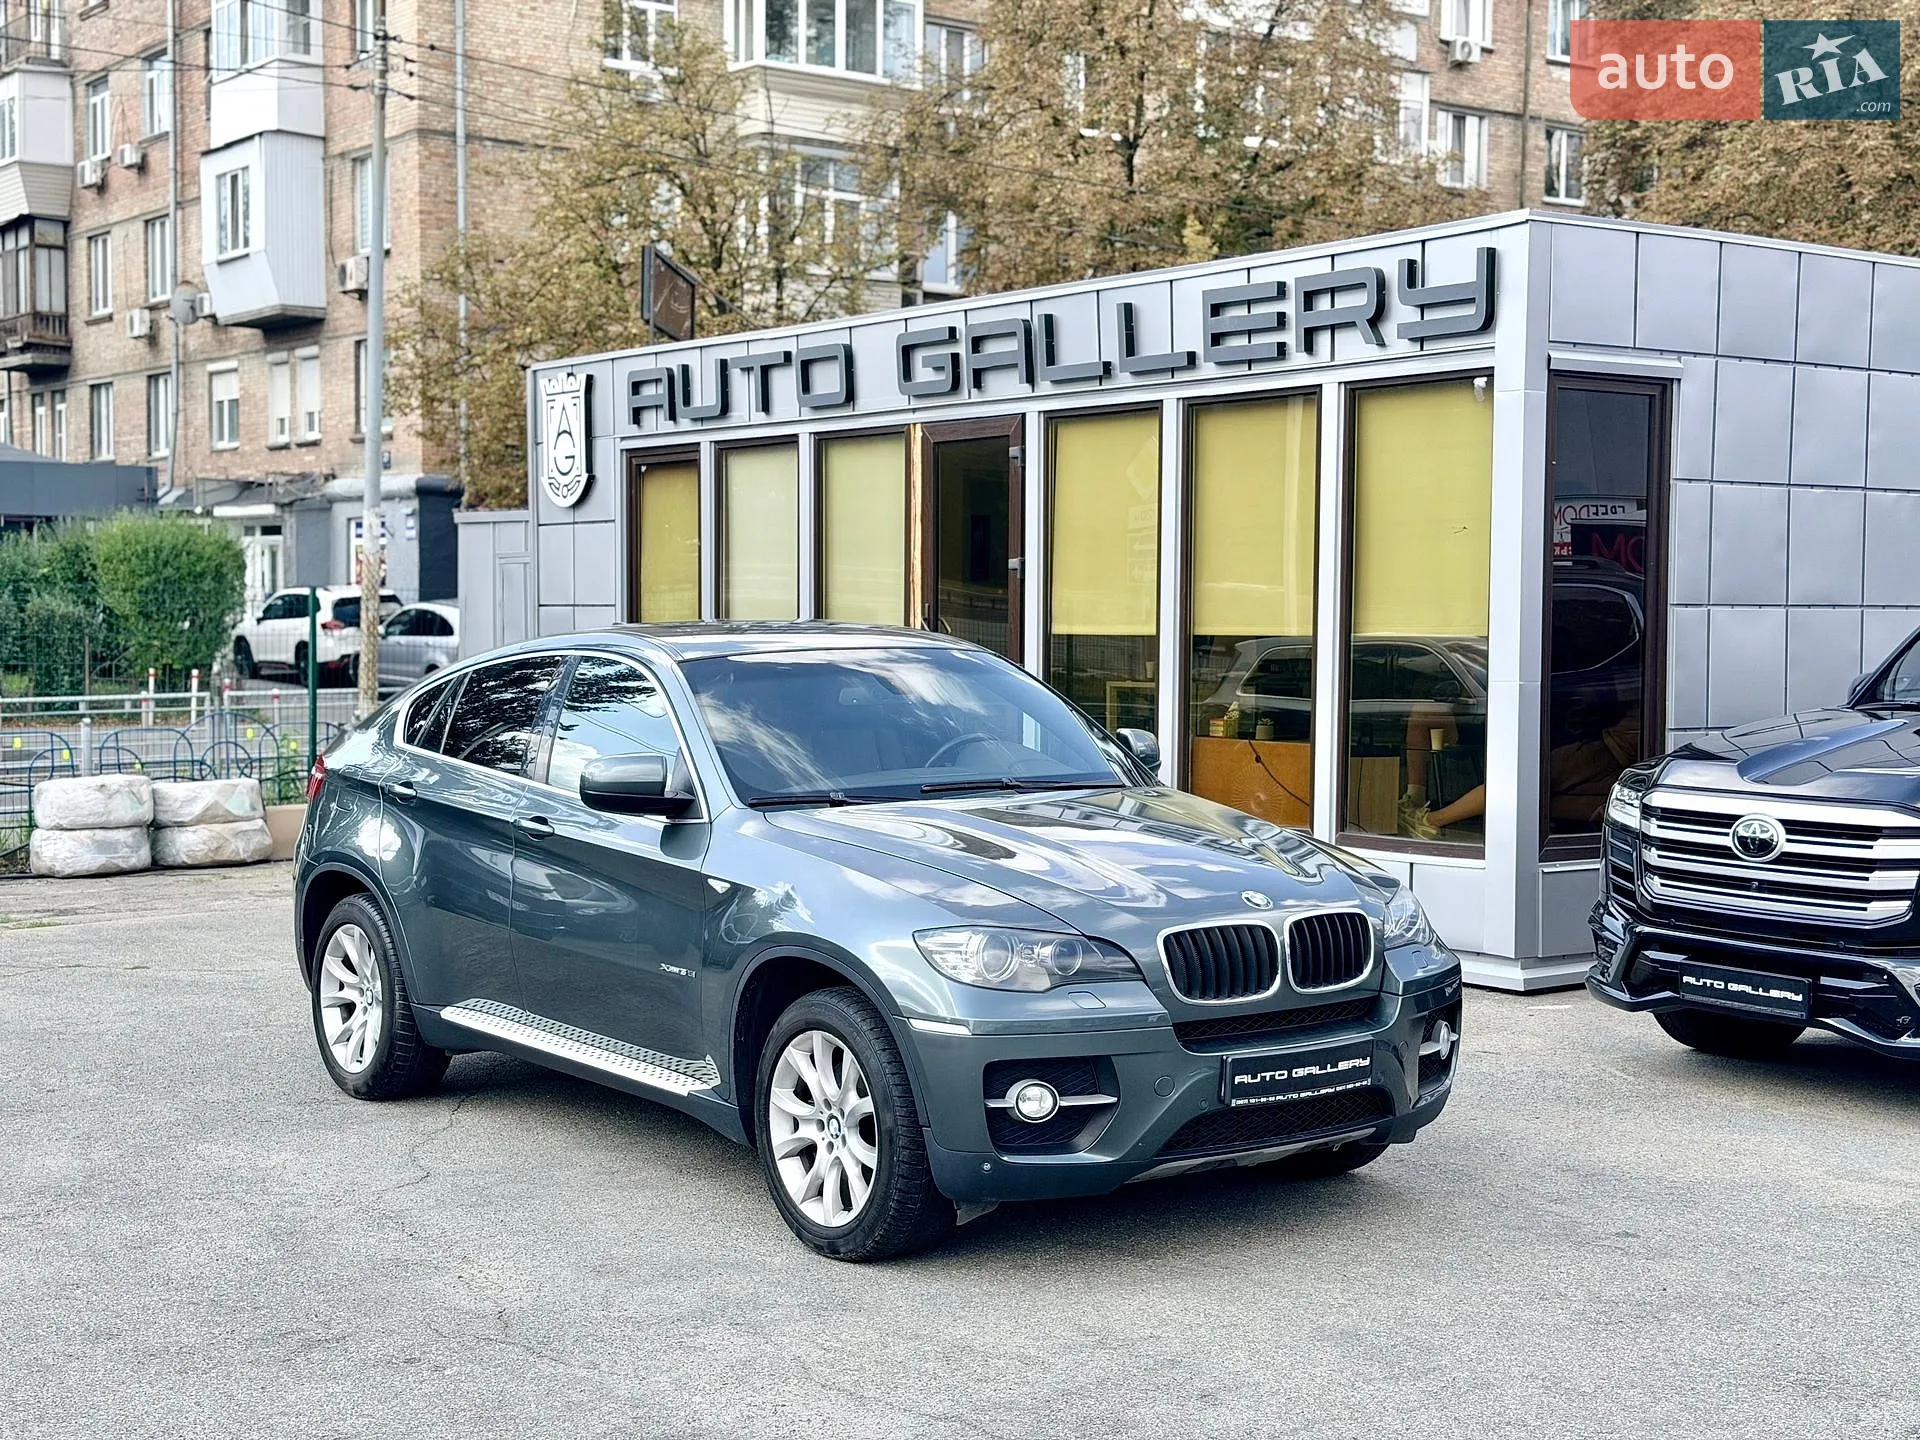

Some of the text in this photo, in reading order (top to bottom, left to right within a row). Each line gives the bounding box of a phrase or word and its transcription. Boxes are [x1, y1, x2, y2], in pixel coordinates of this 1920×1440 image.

[627, 247, 1496, 427] AUTO GALLERY
[1682, 976, 1803, 1002] AUTO GALLERY
[1234, 1056, 1371, 1085] AUTO GALLERY
